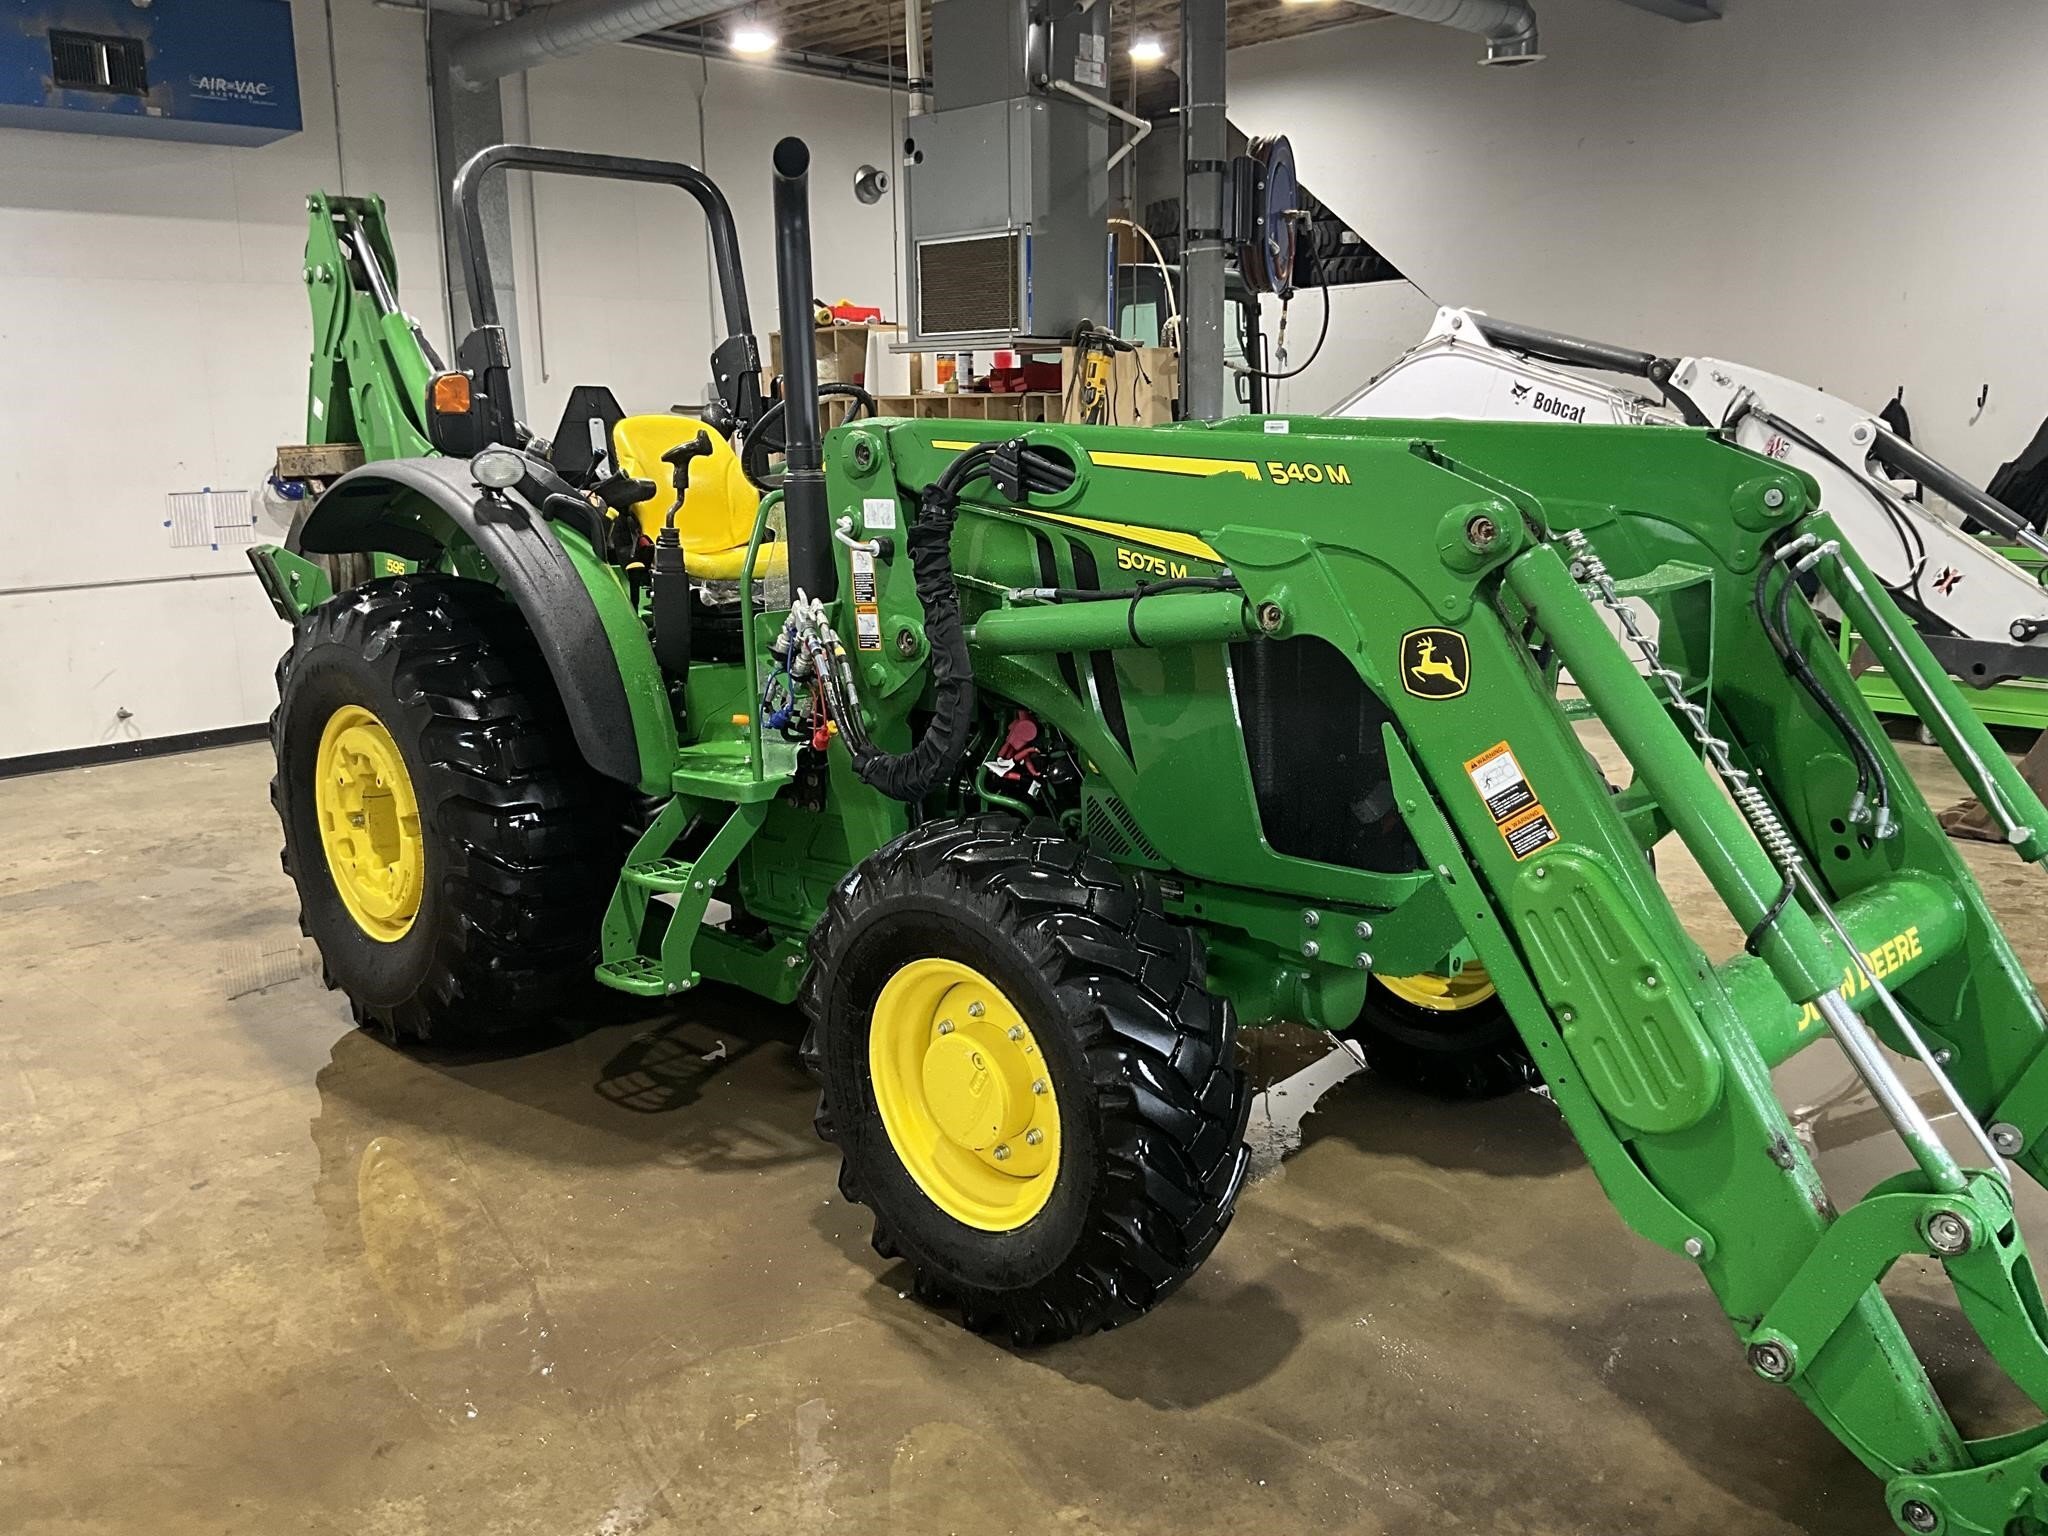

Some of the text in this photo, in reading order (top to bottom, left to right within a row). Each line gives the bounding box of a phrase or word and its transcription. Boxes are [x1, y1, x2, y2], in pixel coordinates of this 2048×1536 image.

[1533, 391, 1586, 424] Bobcat
[1265, 461, 1352, 485] 540 M
[386, 558, 405, 576] 595
[1117, 547, 1188, 579] 5075 M
[1476, 746, 1504, 765] WARNING
[1511, 810, 1540, 829] WARNING
[1850, 926, 1922, 991] DEERE
